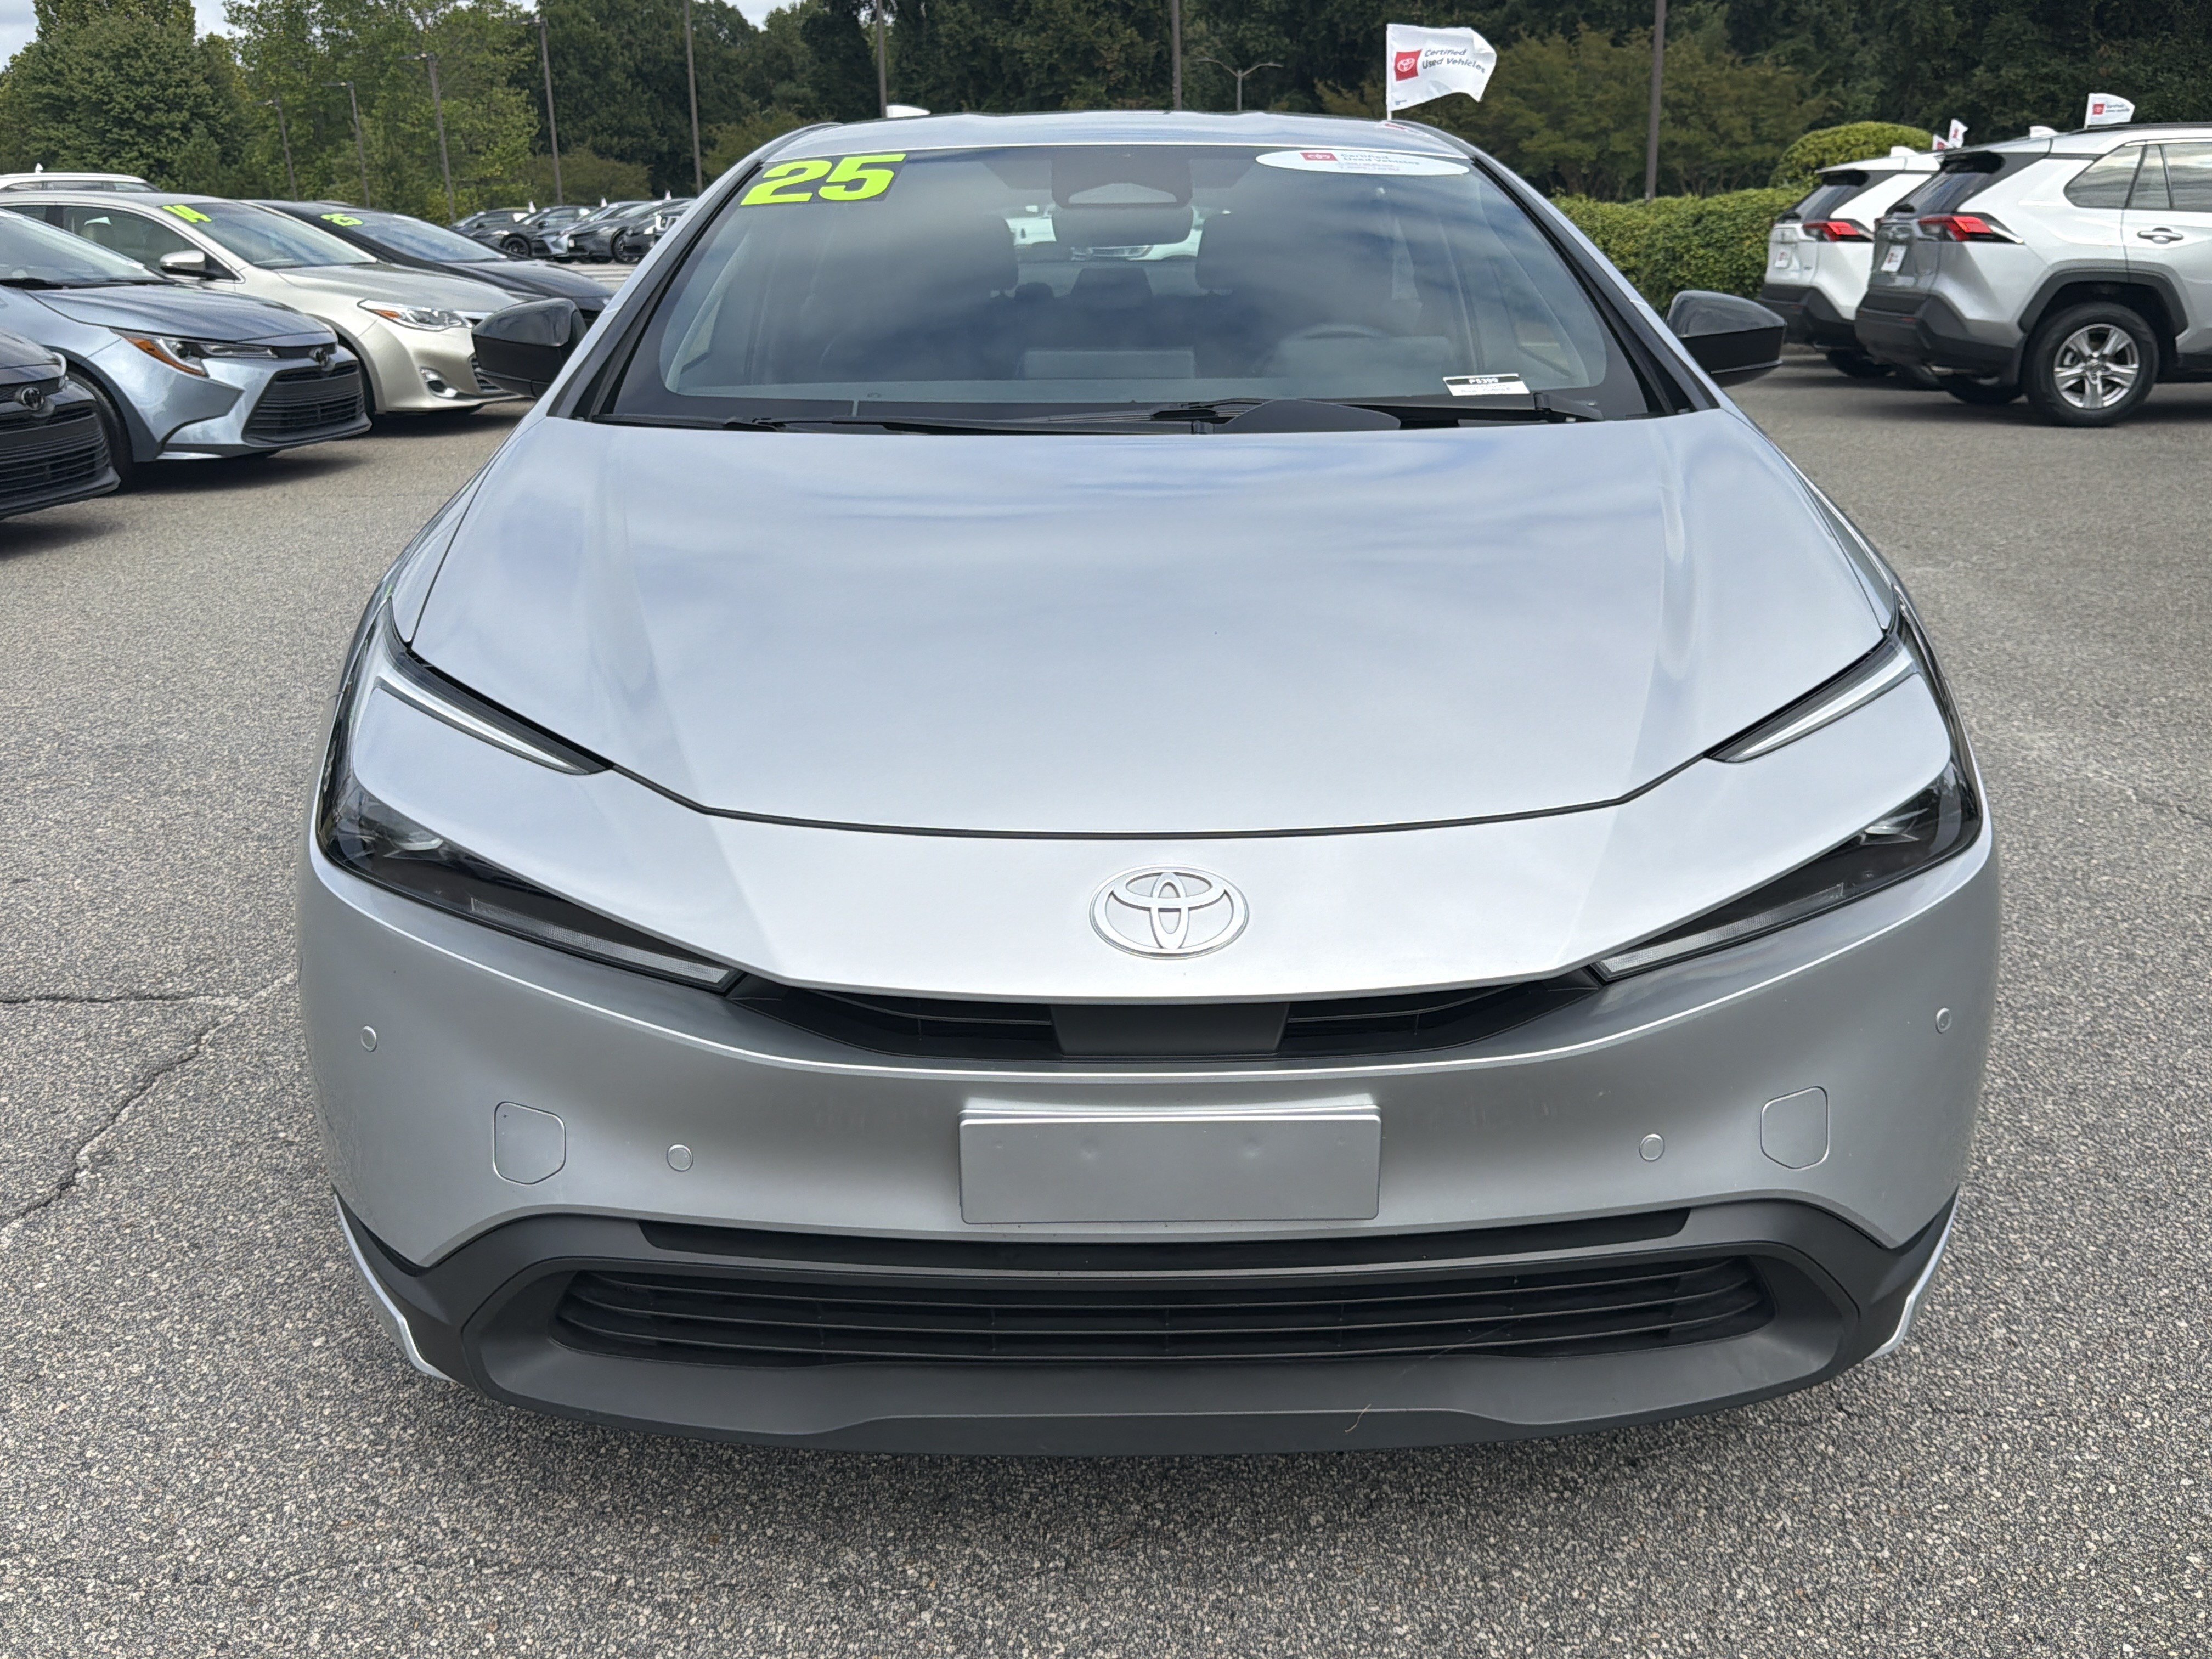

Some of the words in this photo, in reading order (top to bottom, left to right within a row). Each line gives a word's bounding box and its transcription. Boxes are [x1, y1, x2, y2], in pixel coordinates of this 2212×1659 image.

[1425, 49, 1468, 57] Certified
[1422, 58, 1444, 69] Used
[1447, 58, 1486, 73] Vehicles
[741, 154, 907, 206] 25
[162, 205, 212, 223] 14
[320, 213, 363, 226] 25
